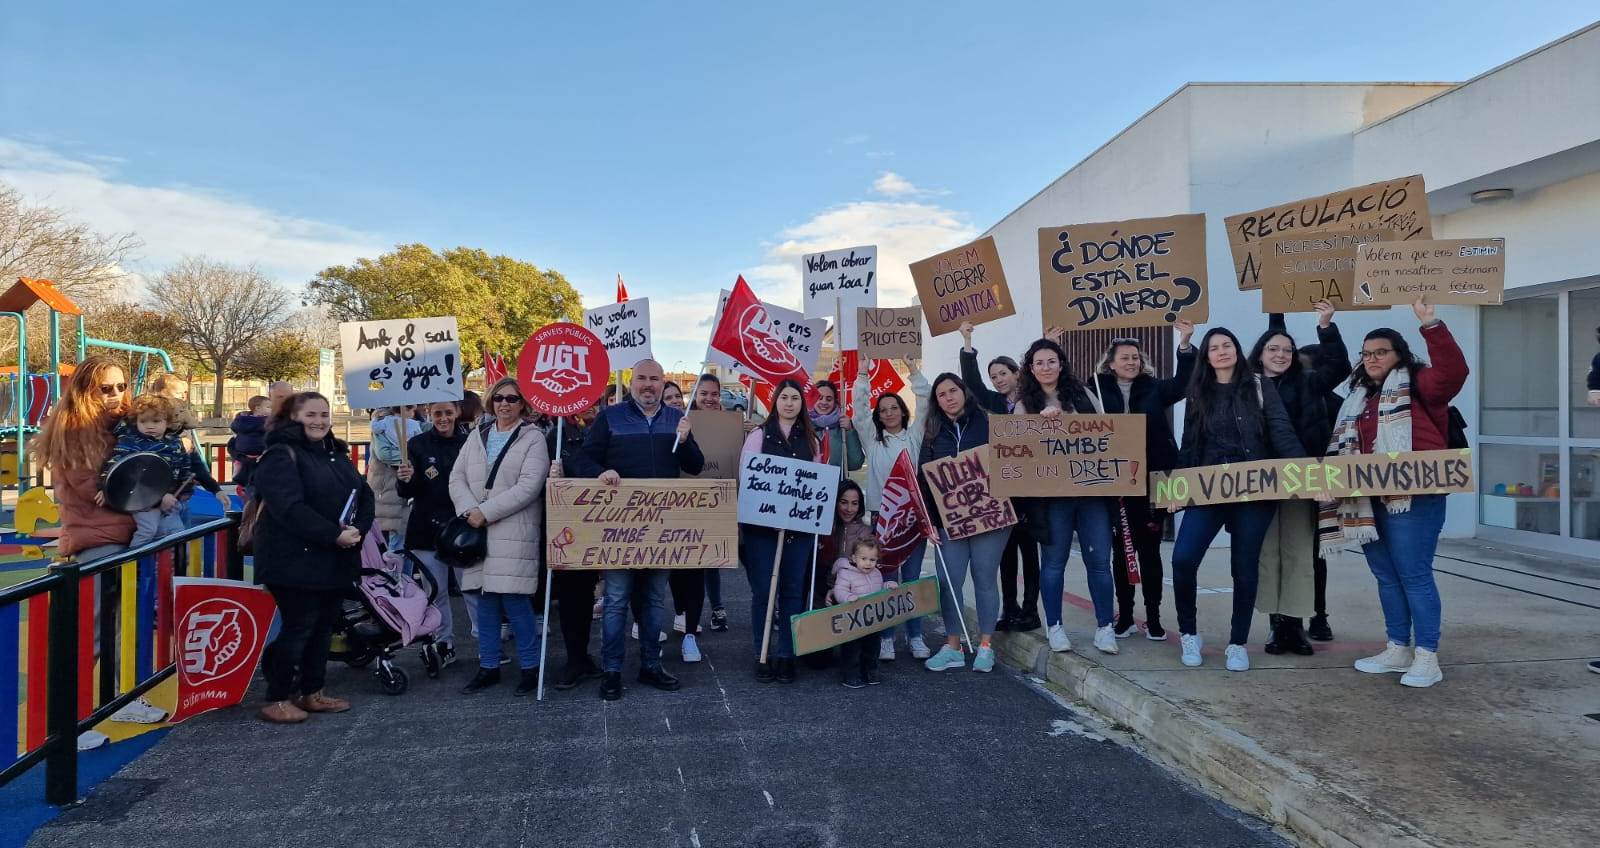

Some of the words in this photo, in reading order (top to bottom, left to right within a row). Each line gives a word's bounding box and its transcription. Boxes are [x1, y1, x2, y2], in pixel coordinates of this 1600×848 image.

[1238, 181, 1410, 242] REGULACIÓ
[806, 253, 838, 274] Volem
[840, 250, 872, 268] cobrar
[1364, 247, 1402, 261] Volem
[1410, 250, 1428, 264] que
[1433, 248, 1453, 258] ens
[1458, 246, 1498, 257] ESTIMIN
[933, 263, 989, 298] COBRAR
[1071, 263, 1131, 292] ESTÁ
[1134, 261, 1171, 282] EL
[1366, 268, 1390, 278] com
[1395, 264, 1445, 276] nosaltres
[1451, 266, 1499, 276] estimam
[809, 281, 835, 300] quan
[1380, 283, 1390, 293] la
[1397, 283, 1438, 293] nostra
[1449, 281, 1486, 292] feina
[588, 312, 604, 329] No
[608, 303, 638, 323] volem
[864, 309, 895, 328] NO
[896, 316, 916, 327] SOM
[939, 296, 970, 323] QUAN
[356, 325, 392, 352] Amb
[397, 323, 416, 347] el
[424, 329, 454, 343] sou
[535, 327, 563, 344] SERVEIS
[565, 327, 594, 346] PÚBLICS
[384, 347, 416, 365] NO
[534, 343, 589, 374] UGT
[369, 366, 393, 381] es
[530, 394, 550, 412] ILLES
[551, 397, 589, 414] BALEARS
[993, 418, 1069, 438] COBRAR
[1068, 419, 1115, 435] QUAN
[992, 443, 1035, 459] TOCA
[1039, 432, 1115, 456] TAMBÉ
[746, 456, 788, 477] Cobrar
[794, 468, 818, 487] quan
[926, 451, 988, 495] VOLEM
[1001, 465, 1024, 480] ES
[1035, 463, 1059, 478] UN
[1156, 475, 1190, 503] NO
[1197, 467, 1279, 501] VOLEM
[1281, 461, 1346, 493] SER
[1346, 457, 1472, 491] INVISIBLES
[572, 488, 618, 506] LES
[626, 489, 720, 509] EDUCADORES
[746, 473, 773, 492] toca
[815, 486, 829, 503] és
[758, 502, 777, 514] un
[945, 520, 977, 539] ENS
[981, 500, 1014, 530] TOCA
[601, 524, 650, 544] TAMBÉ
[657, 528, 705, 544] ESTAN
[830, 591, 916, 635] EXCUSAS
[184, 611, 224, 674] UGT
